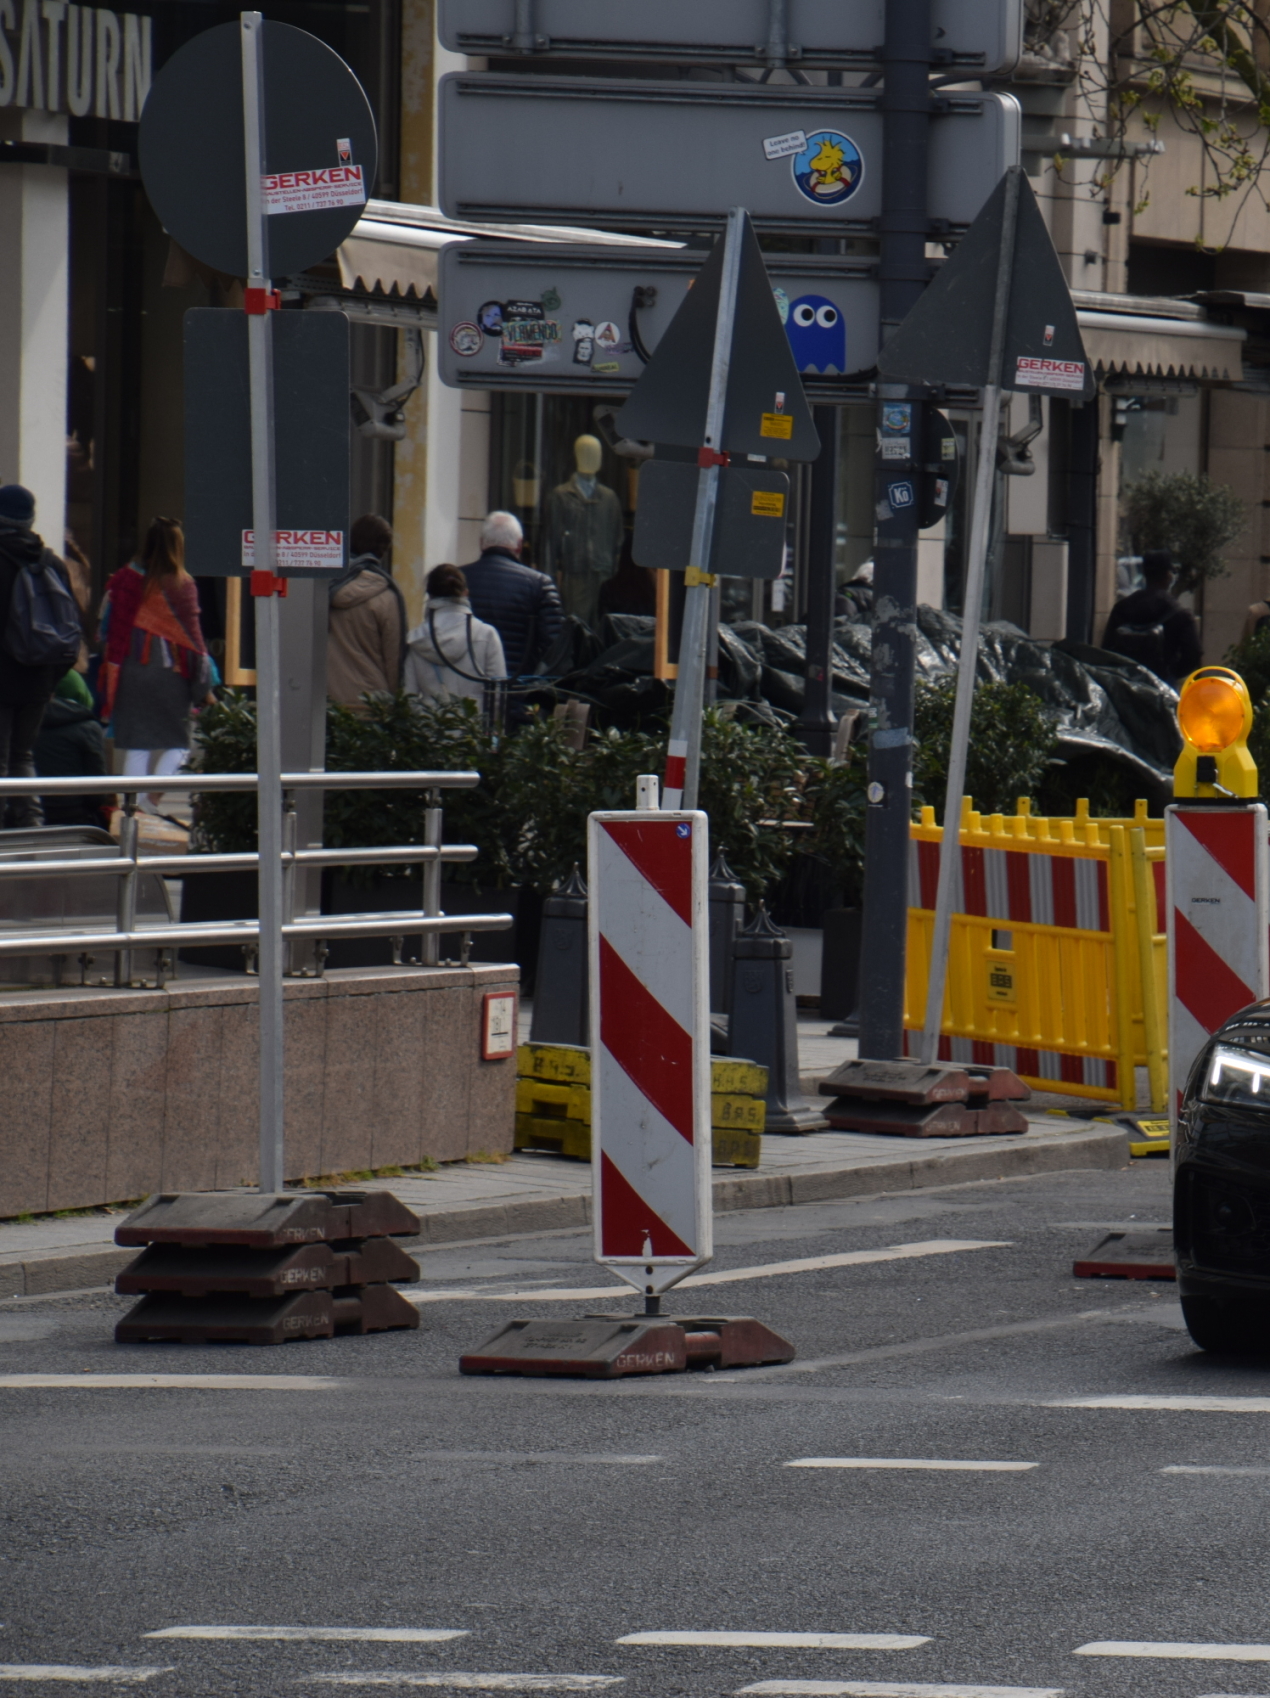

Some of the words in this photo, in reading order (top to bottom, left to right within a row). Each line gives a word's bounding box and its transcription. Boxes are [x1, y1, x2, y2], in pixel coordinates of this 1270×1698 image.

[770, 138, 789, 147] Leave
[262, 166, 361, 190] GERKEN
[1017, 358, 1084, 374] GERKEN
[616, 1352, 676, 1368] GERKEN
